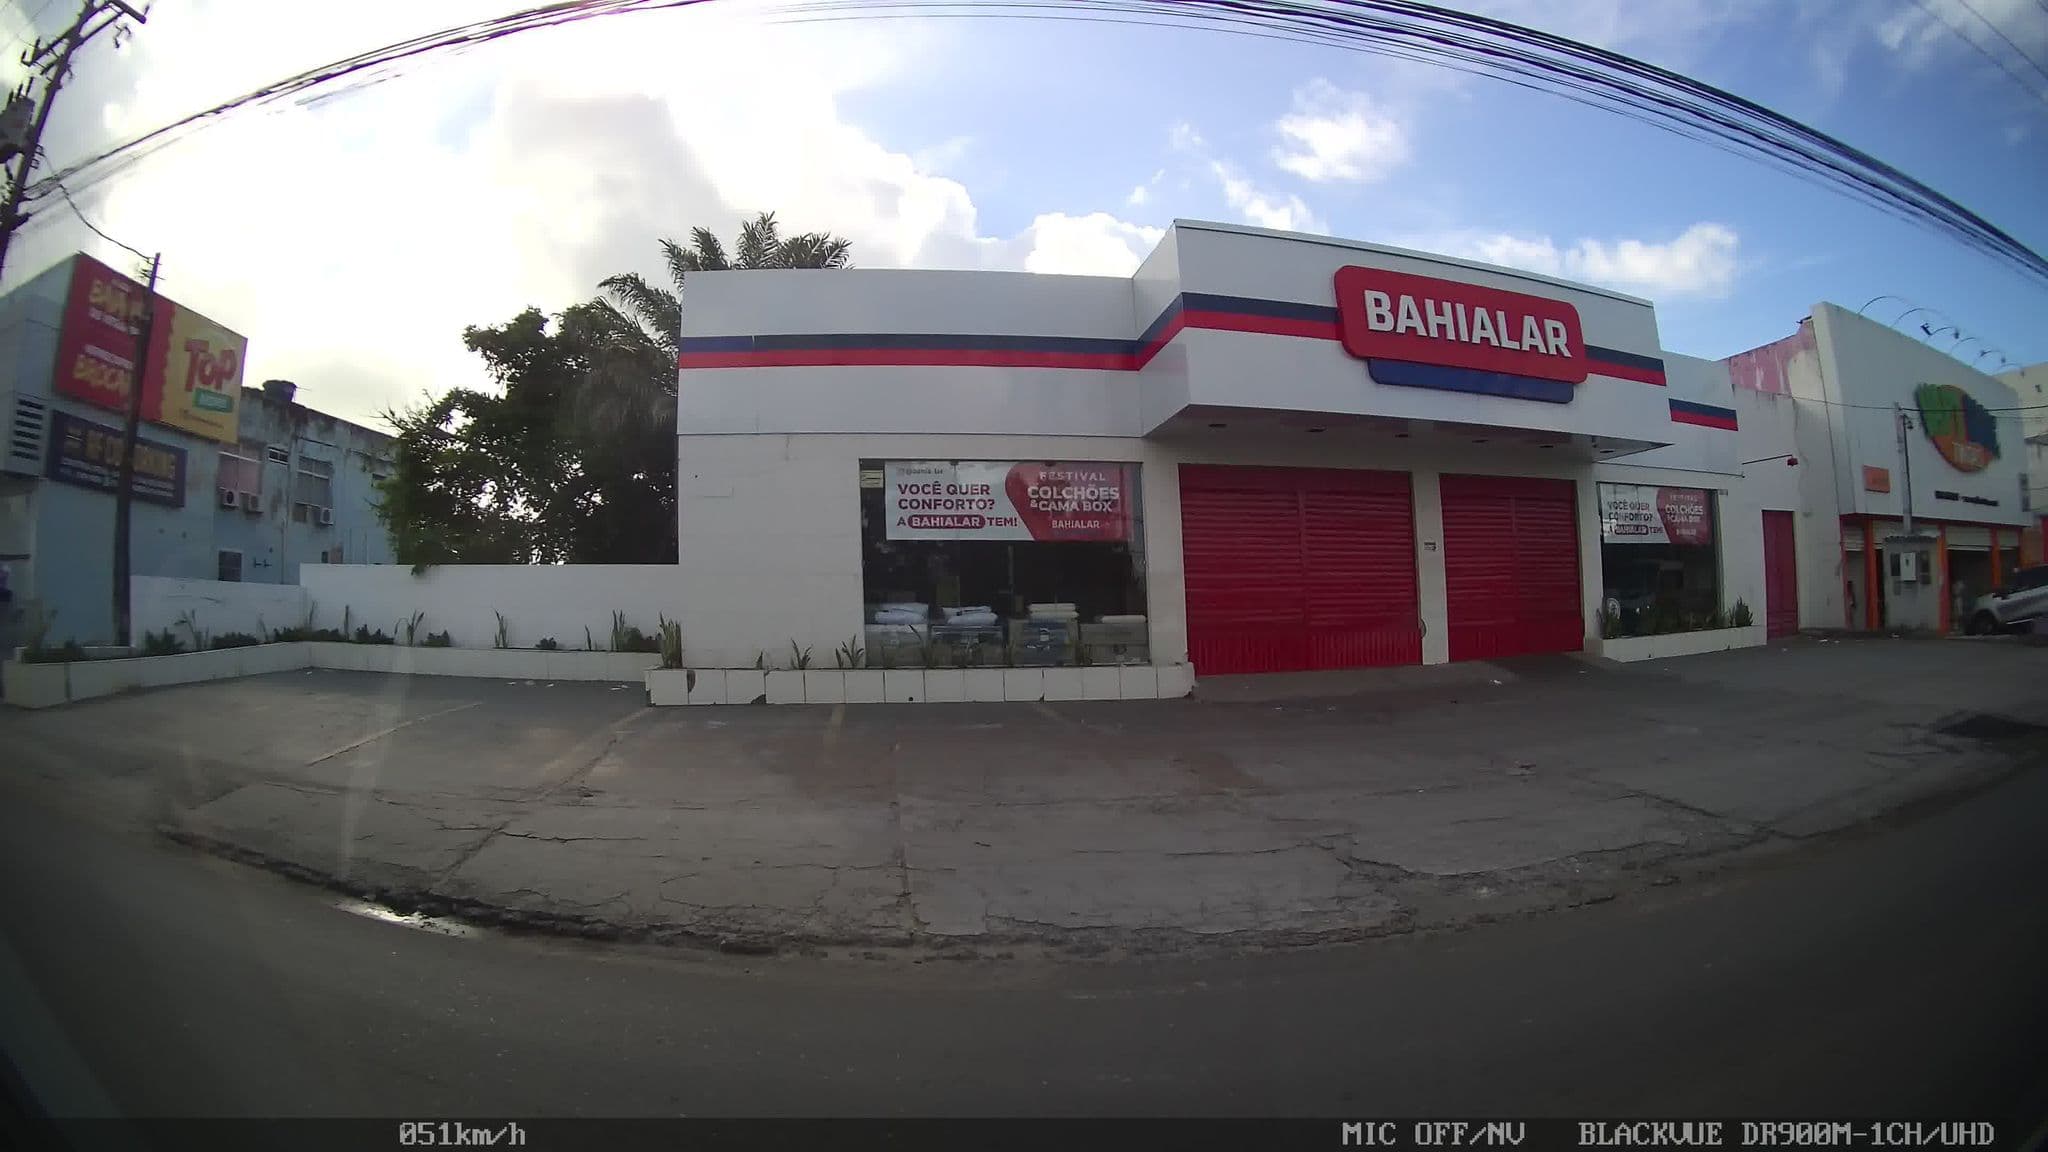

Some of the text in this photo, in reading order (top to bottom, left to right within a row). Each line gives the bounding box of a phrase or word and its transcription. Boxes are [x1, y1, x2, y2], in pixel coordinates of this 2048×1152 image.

[1364, 290, 1571, 358] BAHIALAR
[1039, 471, 1107, 482] FESTIVAL
[898, 481, 991, 497] VOCÊ QUER
[1027, 483, 1120, 500] COLCHÕES
[898, 498, 996, 511] CONFORTO?
[1082, 501, 1113, 513] BOX
[897, 516, 1019, 528] A BAHIALAR TEM!
[1051, 519, 1101, 530] BAHIALAR
